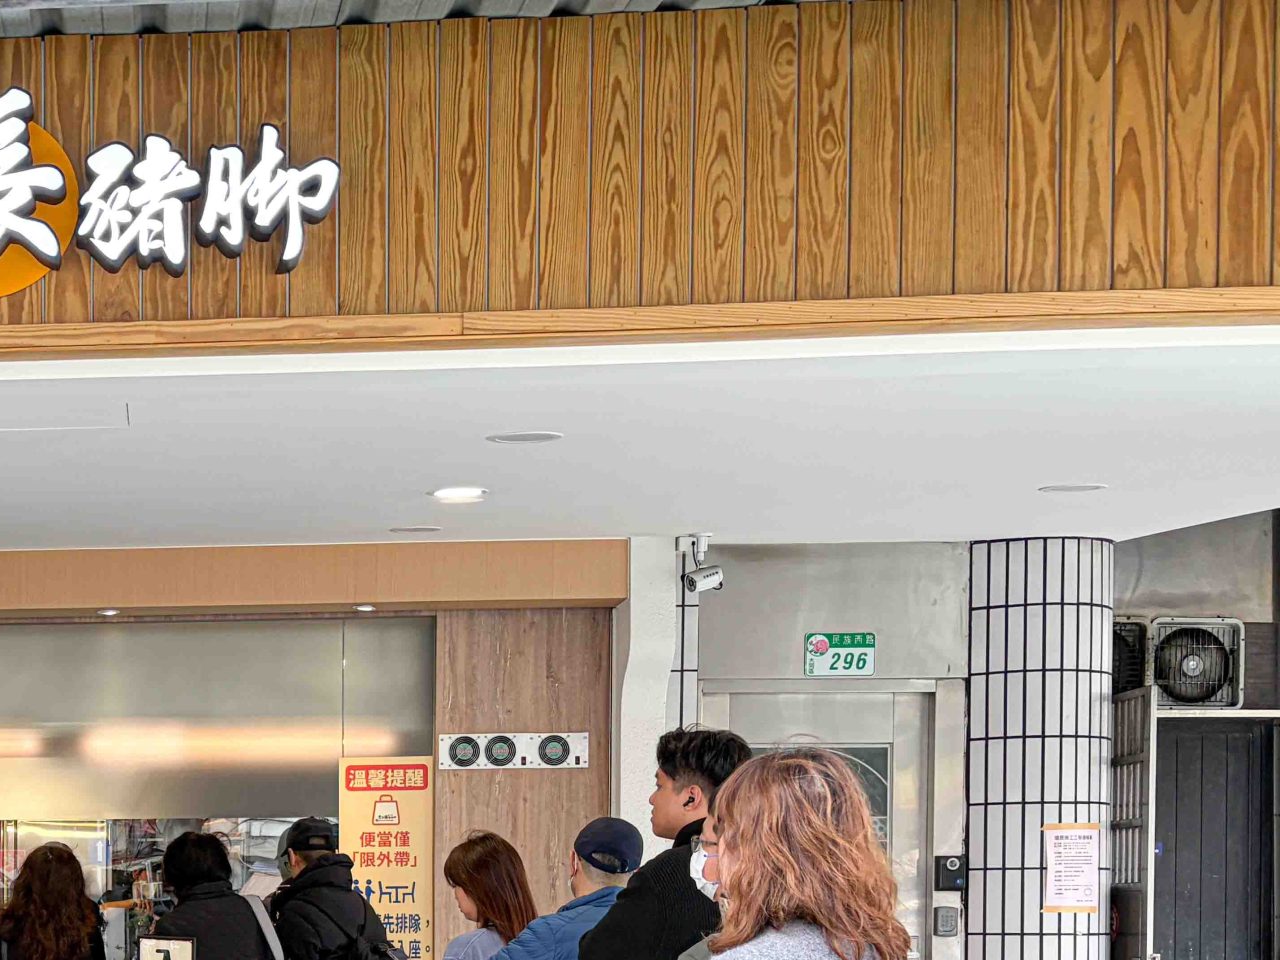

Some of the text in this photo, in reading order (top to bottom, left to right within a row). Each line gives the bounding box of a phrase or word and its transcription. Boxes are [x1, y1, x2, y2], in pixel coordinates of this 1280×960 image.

[832, 634, 874, 645] 民族西路
[829, 652, 868, 671] 296
[349, 768, 424, 788] 溫馨提醒
[360, 831, 411, 848] 便當僅
[376, 913, 430, 934] 先排隊，
